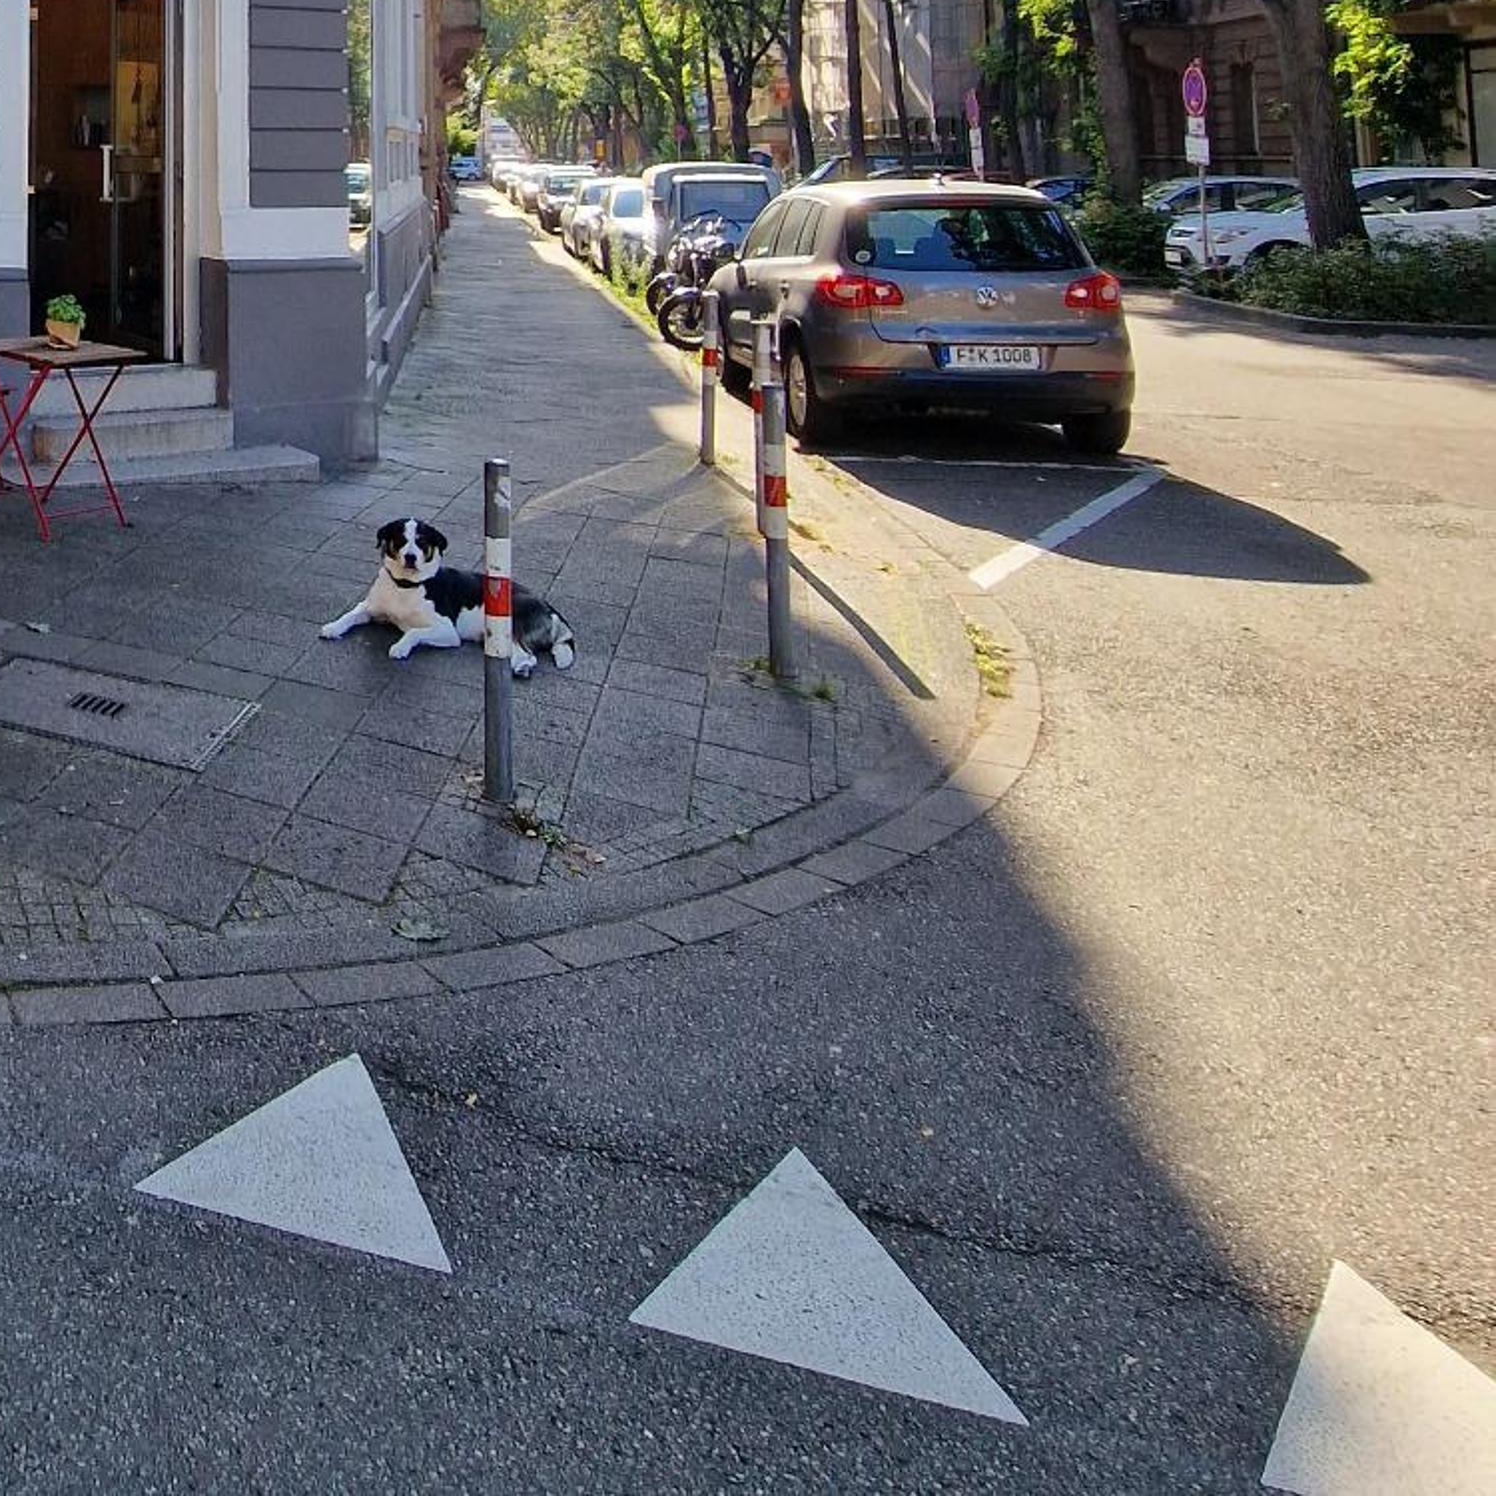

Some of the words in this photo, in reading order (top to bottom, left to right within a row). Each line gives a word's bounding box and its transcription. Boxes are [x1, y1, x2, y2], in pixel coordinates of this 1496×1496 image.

[957, 349, 965, 362] F
[978, 349, 988, 362] K
[992, 349, 1032, 362] 1008
